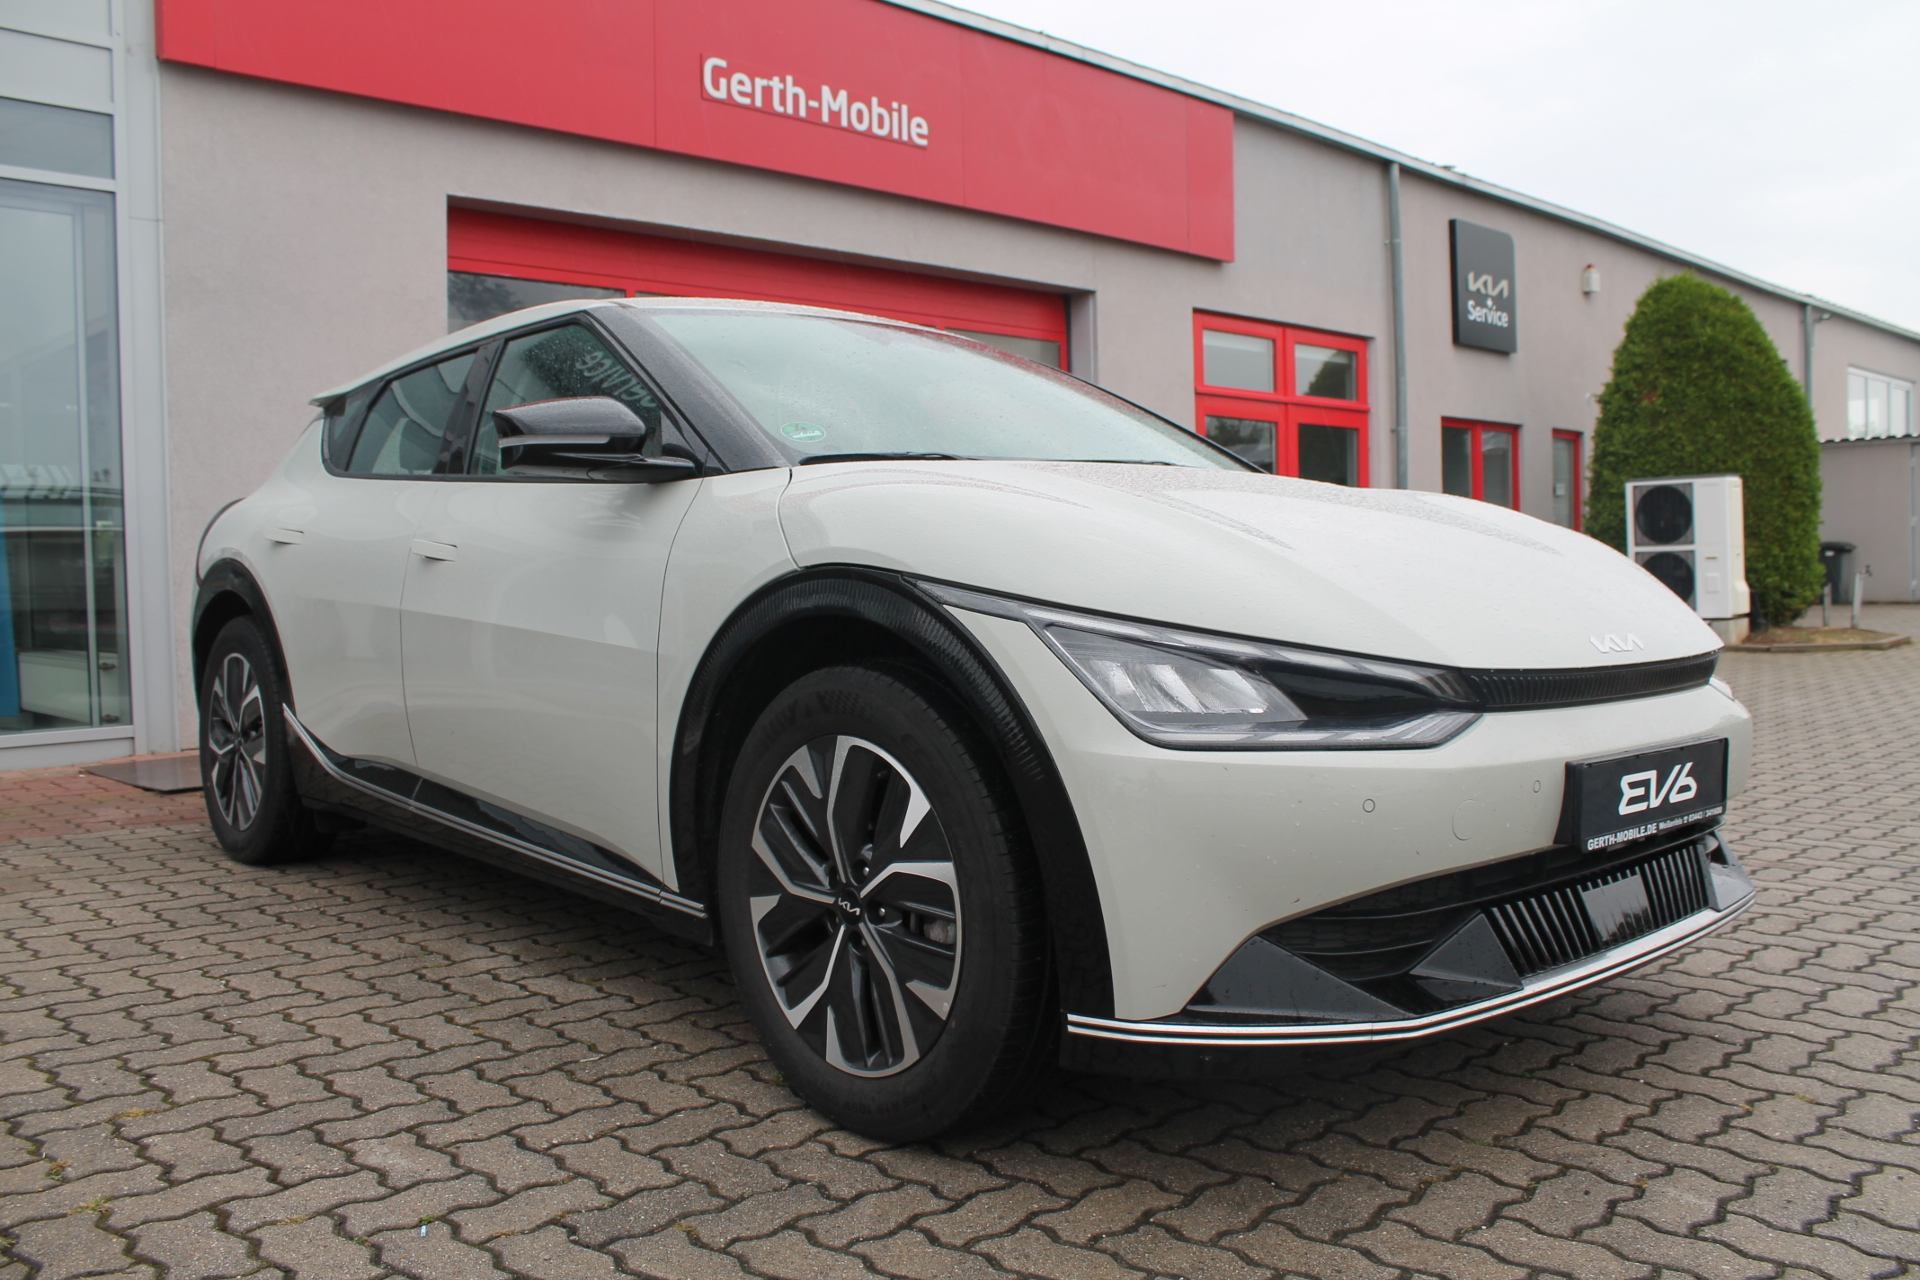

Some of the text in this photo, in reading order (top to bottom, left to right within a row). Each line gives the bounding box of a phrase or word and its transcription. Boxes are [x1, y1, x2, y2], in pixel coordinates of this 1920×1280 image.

[703, 57, 929, 146] Gerth-Mobile
[1467, 271, 1509, 299] KIA
[1467, 299, 1509, 328] Service
[1589, 632, 1644, 654] KIA
[1618, 762, 1697, 815] EV6
[1587, 823, 1657, 851] GERTH-MOBILE.DE
[838, 897, 860, 915] KIA
